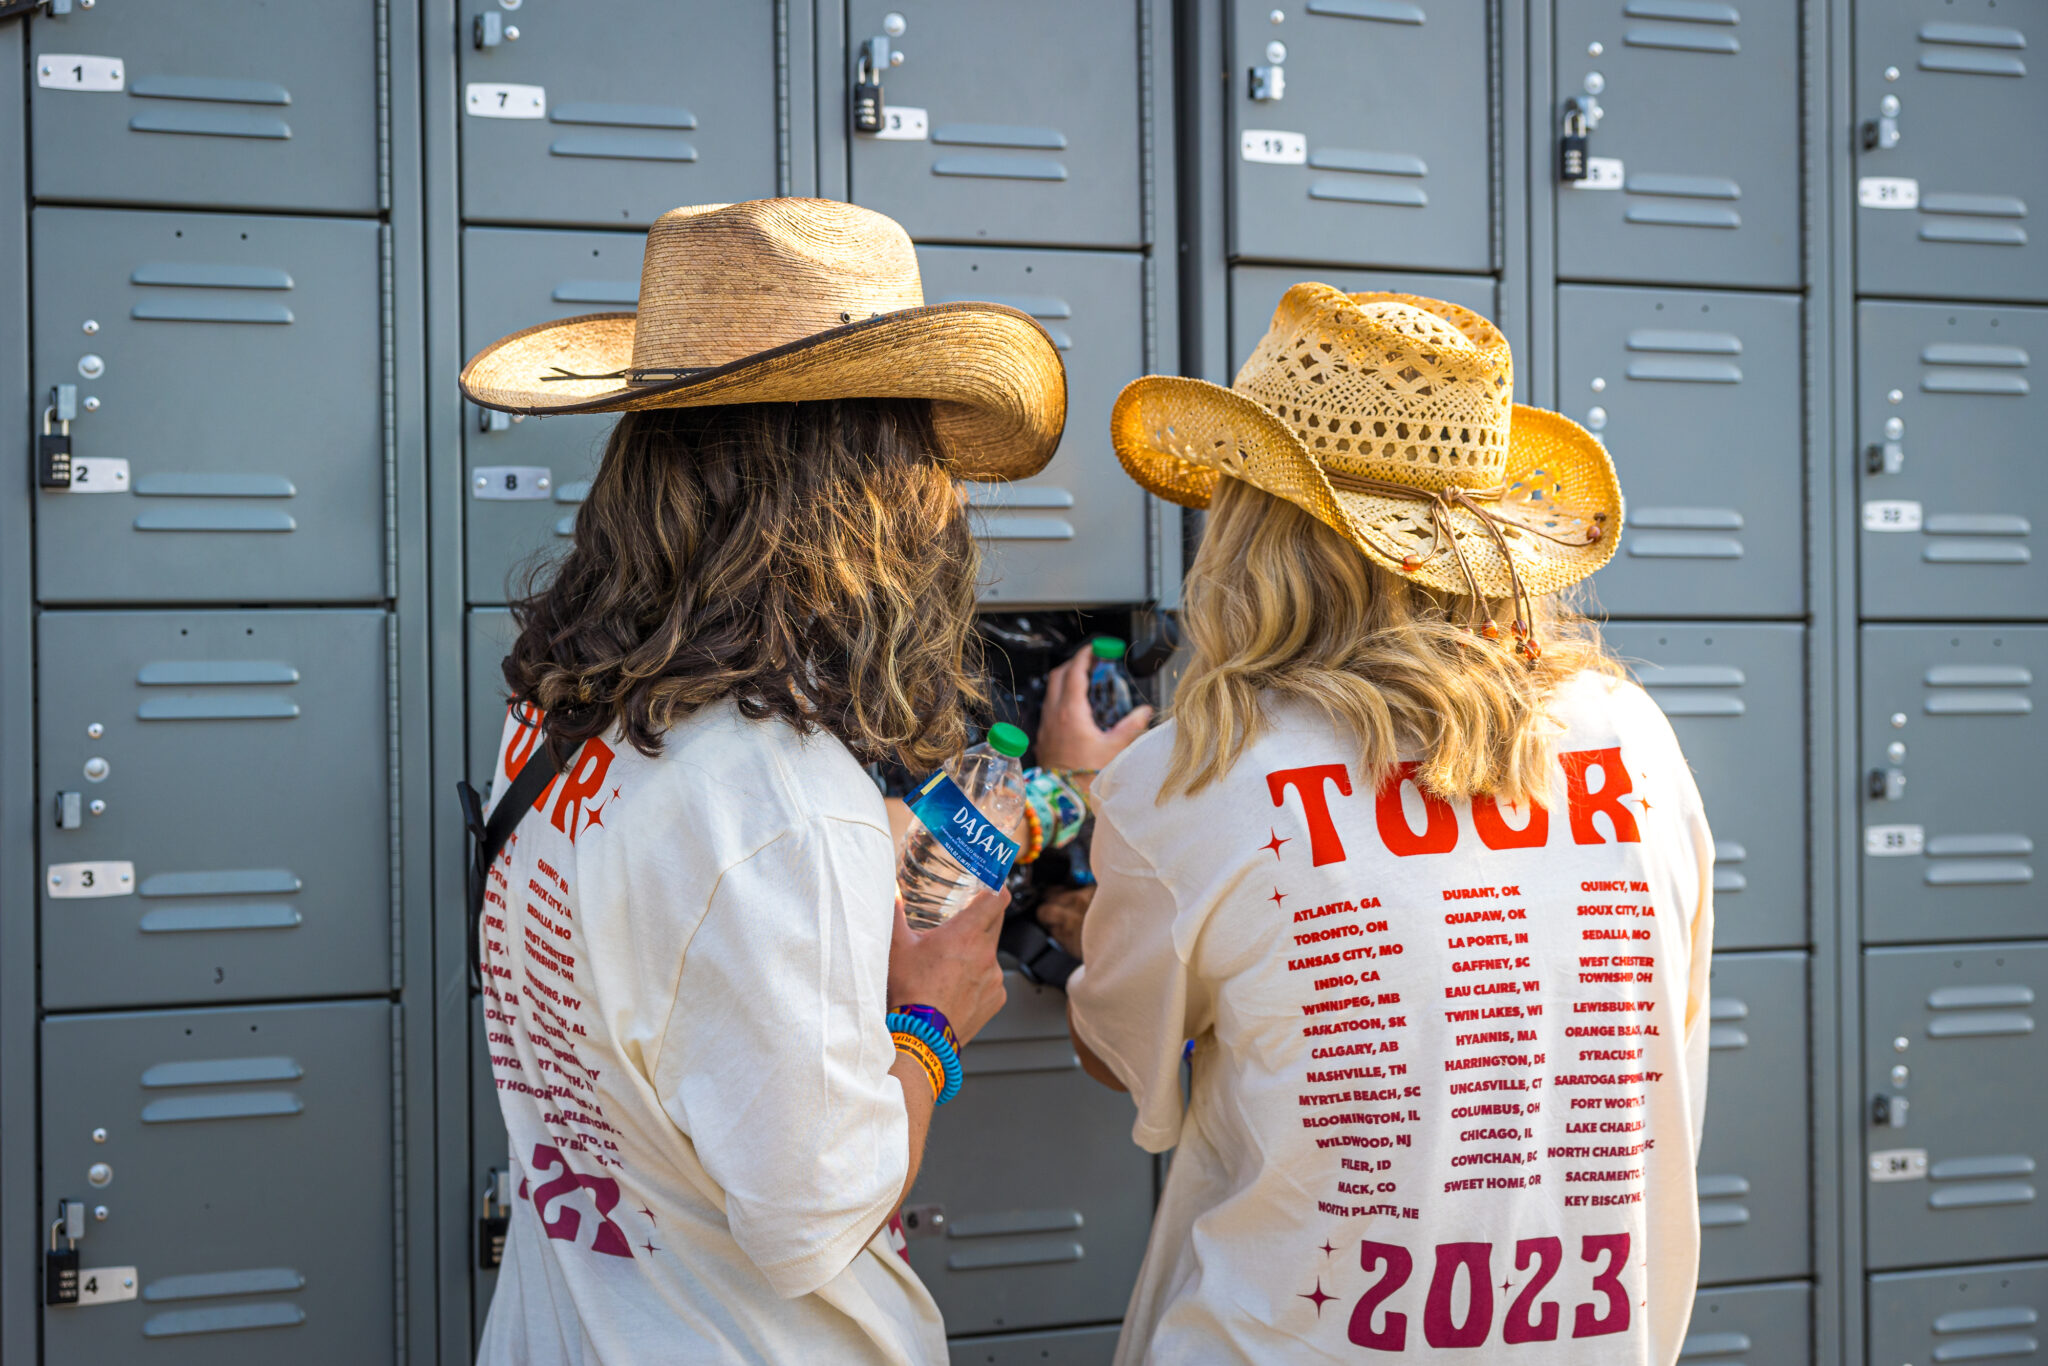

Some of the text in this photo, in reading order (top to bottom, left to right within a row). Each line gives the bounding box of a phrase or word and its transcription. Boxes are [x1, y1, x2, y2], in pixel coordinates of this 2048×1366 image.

[72, 64, 82, 82] 1
[496, 91, 508, 107] 7
[891, 114, 901, 130] 3
[76, 466, 88, 482] 2
[505, 473, 517, 490] 8
[953, 806, 1014, 866] DASANI
[82, 870, 94, 888] 3
[1581, 880, 1649, 893] QUINCY, WA
[1442, 885, 1520, 901] DURANT, OK
[1293, 897, 1382, 923] ATLANTA, GA
[1445, 908, 1527, 925] QUAPAW, OK
[1577, 905, 1655, 917] SIOUX CITY, IA
[554, 924, 572, 941] MO
[1293, 920, 1389, 946] TORONTO, ON
[1448, 932, 1528, 949] LA PORTE, IN
[1632, 929, 1651, 940] MO
[1288, 944, 1403, 971] KANSAS CITY, MO
[1452, 957, 1530, 973] GAFFNEY, SC
[1579, 956, 1609, 967] WEST
[1314, 970, 1380, 991] INDIO, CA
[1636, 972, 1653, 982] OH
[1445, 980, 1539, 998] EAU CLAIRE, WI
[562, 994, 581, 1011] WV
[1302, 993, 1400, 1016] WINNIPEG, MB
[1637, 1001, 1655, 1011] WV
[1444, 1005, 1543, 1022] TWIN LAKES, WI
[572, 1023, 587, 1037] AL
[1388, 1016, 1407, 1028] SK
[1456, 1030, 1537, 1046] HYANNIS, MA
[1565, 1026, 1615, 1037] ORANGE
[1644, 1025, 1659, 1036] AL
[1312, 1041, 1399, 1059] CALGARY, AB
[1445, 1055, 1532, 1071] HARRINGTON,
[1307, 1064, 1407, 1082] NASHVILLE, TN
[1555, 1074, 1616, 1085] SARATOGA
[1645, 1071, 1664, 1082] NY
[1450, 1078, 1542, 1095] UNCASVILLE, CT
[1299, 1086, 1420, 1106] MYRTLE BEACH, SC
[1571, 1098, 1602, 1109] FORT
[1451, 1103, 1540, 1118] COLUMBUS, OH
[1303, 1110, 1420, 1128] BLOOMINGTON, IL
[1460, 1128, 1532, 1142] CHICAGO, IL
[1566, 1123, 1597, 1133] LAKE
[1315, 1135, 1411, 1149] WILDWOOD, NJ
[1451, 1150, 1538, 1167] COWICHAN, BC
[1548, 1147, 1589, 1157] NORTH
[1377, 1159, 1392, 1171] ID
[1376, 1182, 1397, 1193] CO
[1445, 1175, 1541, 1192] SWEET HOME, OR
[1565, 1196, 1588, 1206] KEY
[1351, 1204, 1401, 1219] PLATTE,
[1402, 1207, 1420, 1220] NE
[84, 1276, 98, 1295] 4
[1347, 1232, 1631, 1352] 2023
